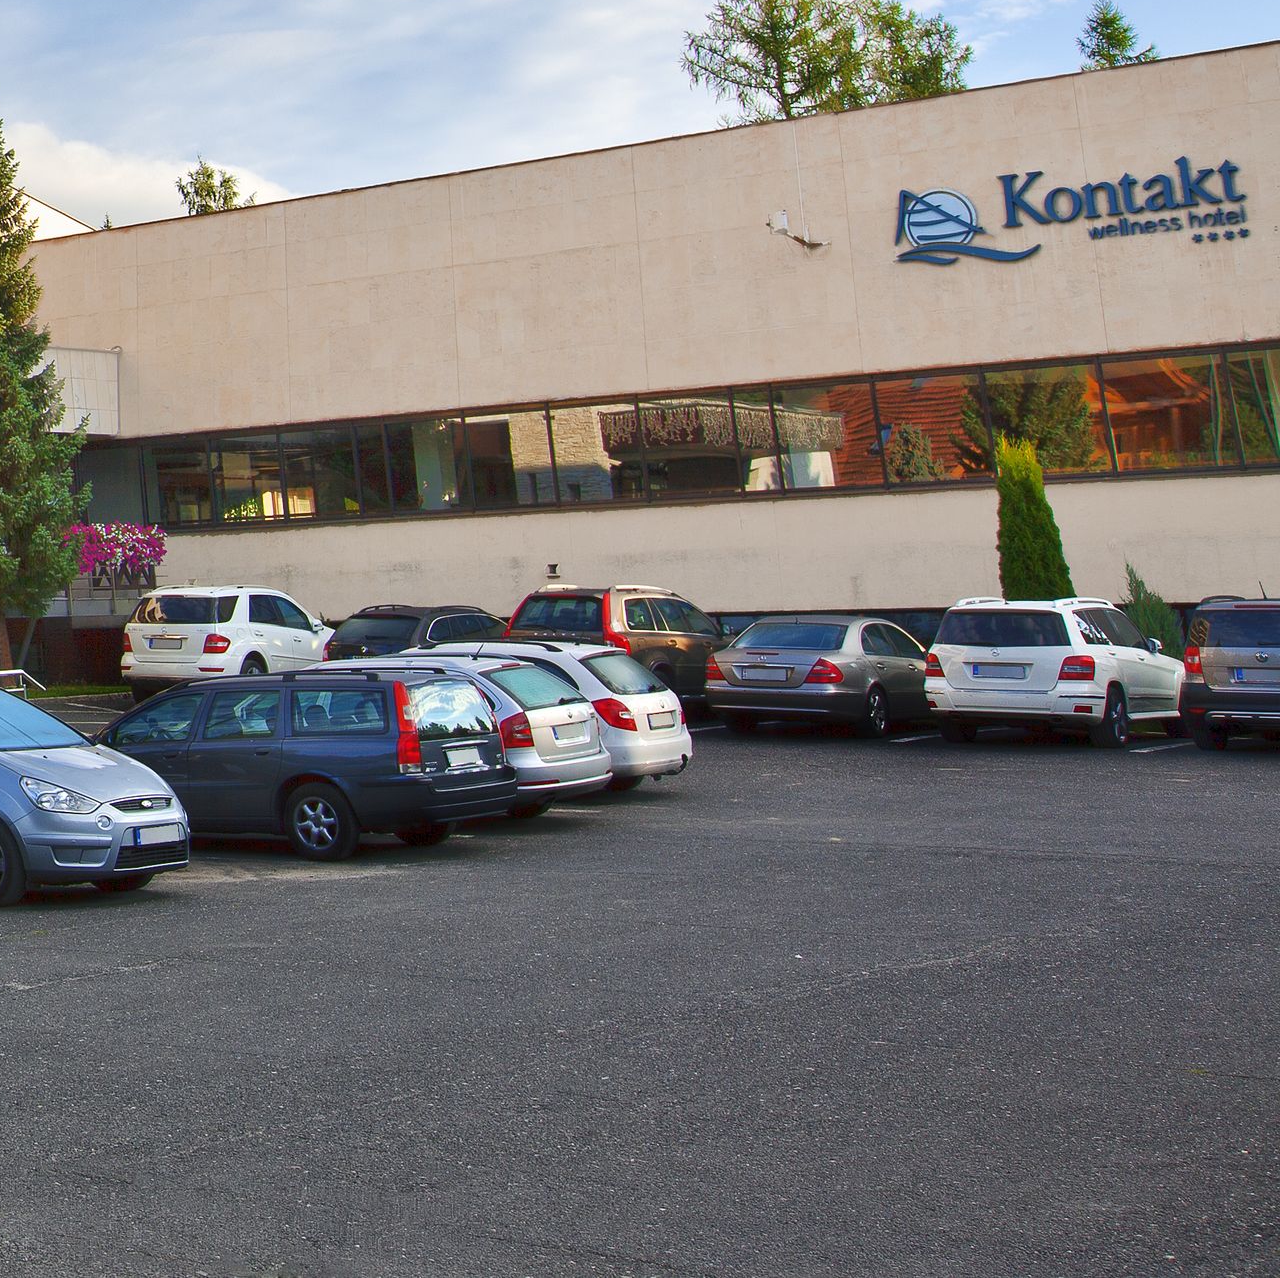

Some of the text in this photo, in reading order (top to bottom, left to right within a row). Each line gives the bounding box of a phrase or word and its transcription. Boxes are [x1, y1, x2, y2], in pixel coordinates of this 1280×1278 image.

[997, 155, 1247, 229] Kontakt
[1088, 204, 1248, 241] wellness hotel
